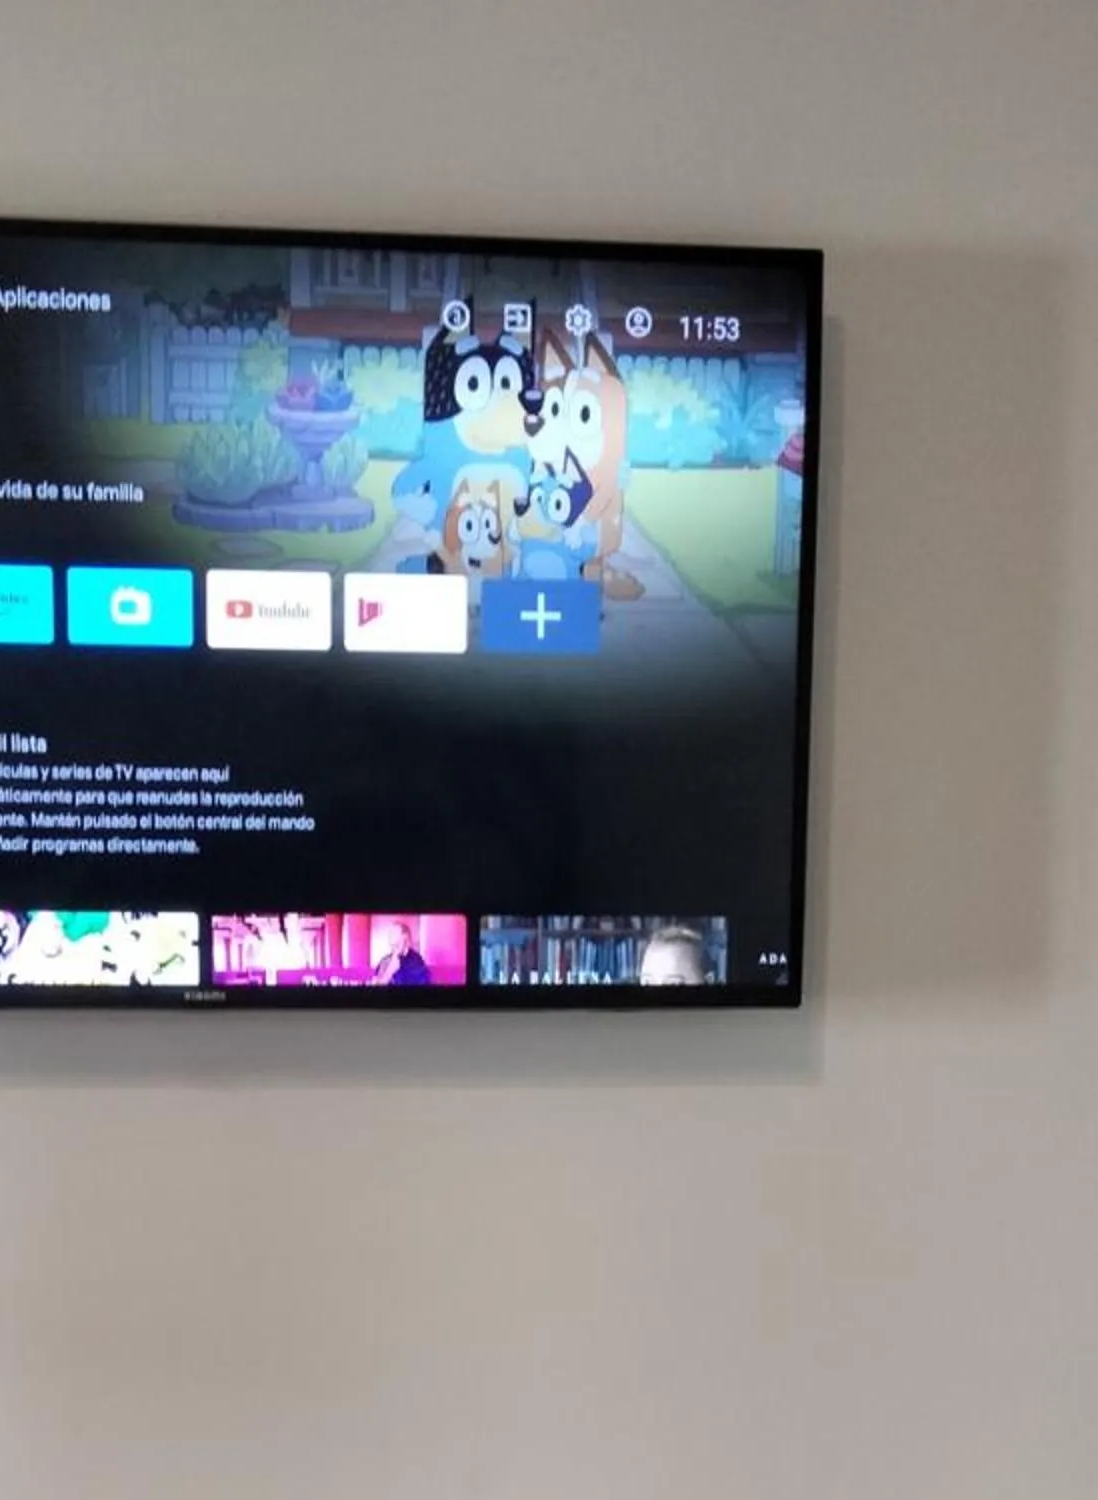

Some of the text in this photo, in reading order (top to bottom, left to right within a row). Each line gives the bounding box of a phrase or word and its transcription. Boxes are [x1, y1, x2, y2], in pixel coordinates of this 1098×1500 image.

[680, 315, 740, 341] 11:53
[36, 481, 58, 500] de
[62, 484, 82, 501] su
[86, 481, 143, 502] familia
[10, 733, 47, 754] lista
[40, 766, 50, 783] y
[52, 764, 92, 781] series
[95, 764, 113, 781] de
[115, 764, 133, 781] TV
[135, 766, 199, 784] aparecen
[75, 789, 105, 807] para
[107, 790, 134, 808] que
[135, 788, 198, 806] reanudes
[200, 789, 213, 806] la
[83, 811, 137, 831] pulsado
[139, 813, 152, 830] el
[197, 813, 243, 832] central
[245, 813, 266, 832] del
[268, 815, 316, 832] mando
[31, 837, 104, 857] programas
